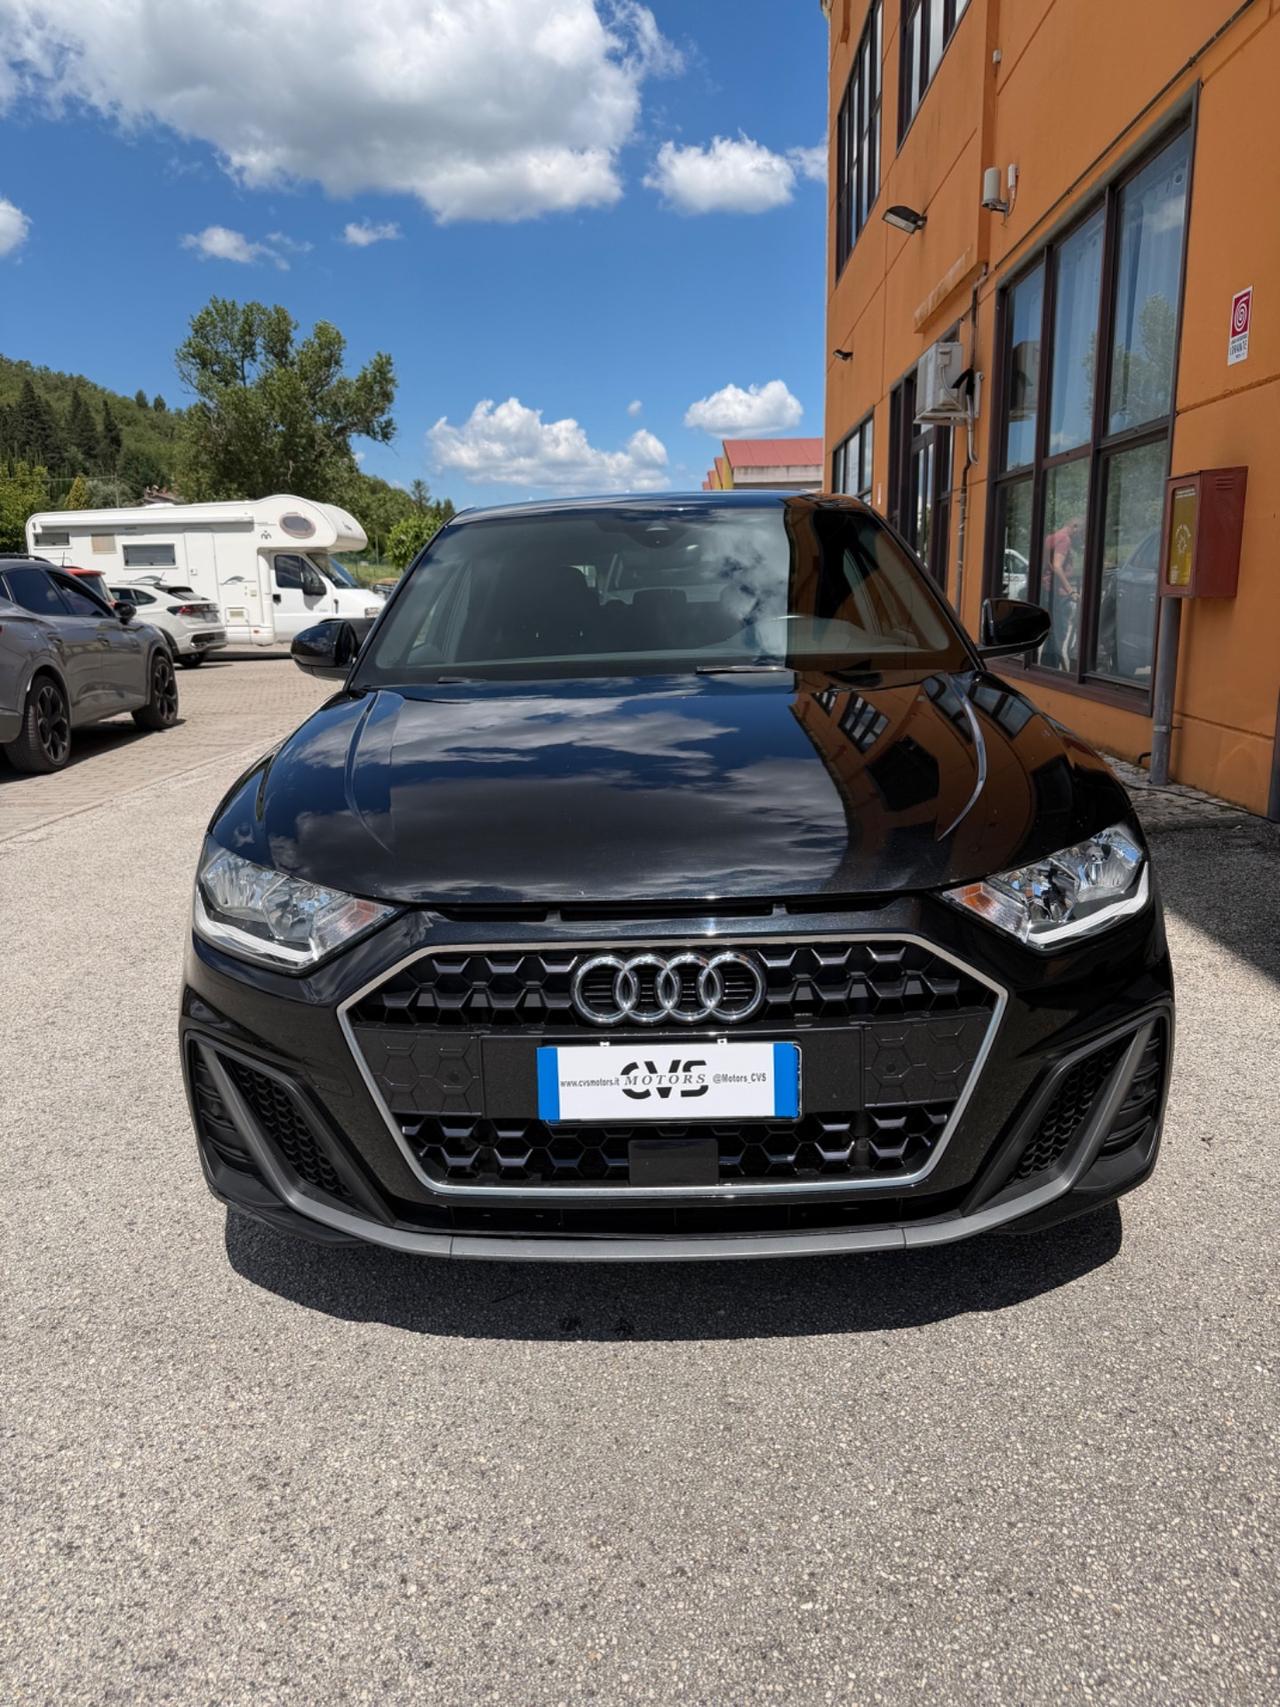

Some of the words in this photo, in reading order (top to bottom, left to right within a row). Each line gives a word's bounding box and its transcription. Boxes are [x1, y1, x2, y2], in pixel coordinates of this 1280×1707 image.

[560, 1077, 620, 1088] www.cvsmotors.it
[620, 1059, 709, 1099] CVS
[624, 1073, 706, 1086] MOTORS
[713, 1072, 767, 1085] @Motors_CVS
